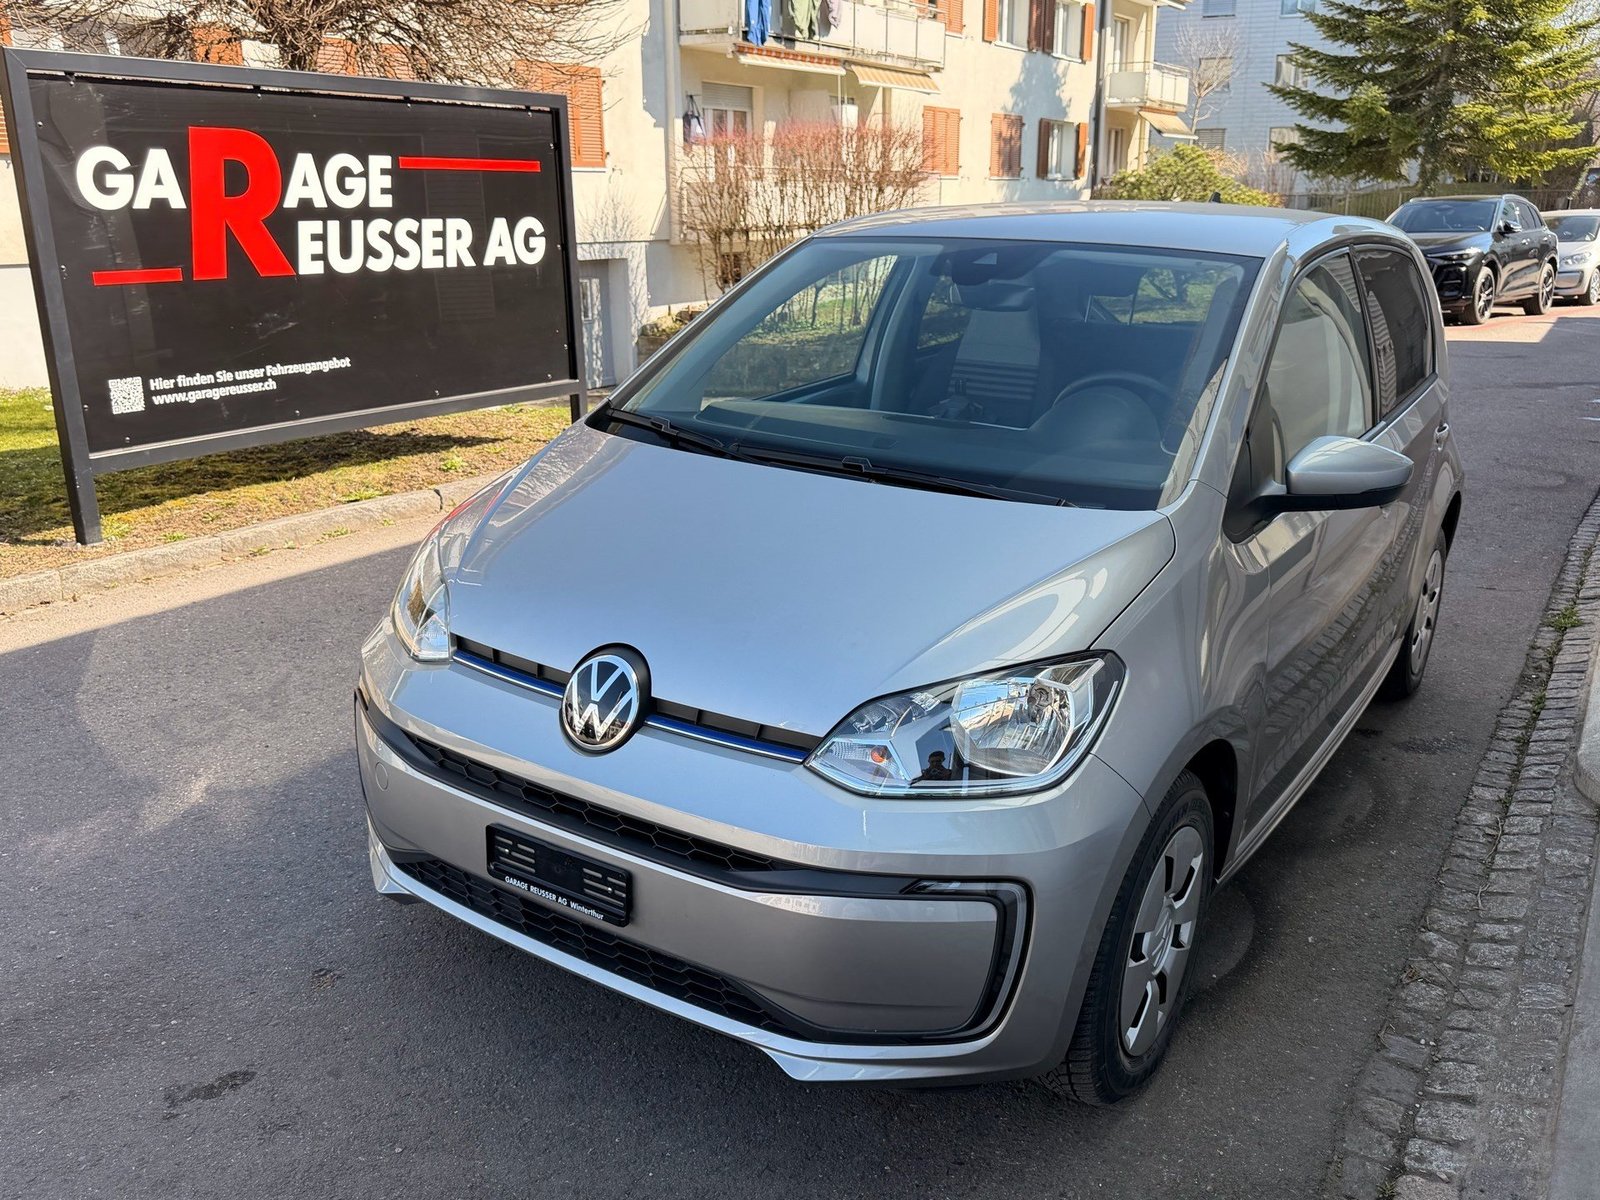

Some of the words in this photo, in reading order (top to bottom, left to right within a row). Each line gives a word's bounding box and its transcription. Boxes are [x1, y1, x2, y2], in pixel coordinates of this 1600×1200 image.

[76, 126, 393, 281] GARAGE
[483, 216, 546, 266] AG
[149, 377, 176, 391] Hier
[176, 373, 215, 388] finden
[215, 369, 234, 383] Sie
[234, 367, 265, 381] unser
[265, 356, 352, 376] Fahrzeugangebot
[151, 378, 277, 405] www.garagereusser.ch
[504, 875, 529, 891] GARAGE
[529, 885, 557, 901] REUSSER
[557, 896, 568, 906] AG
[570, 900, 605, 920] Winterthur
